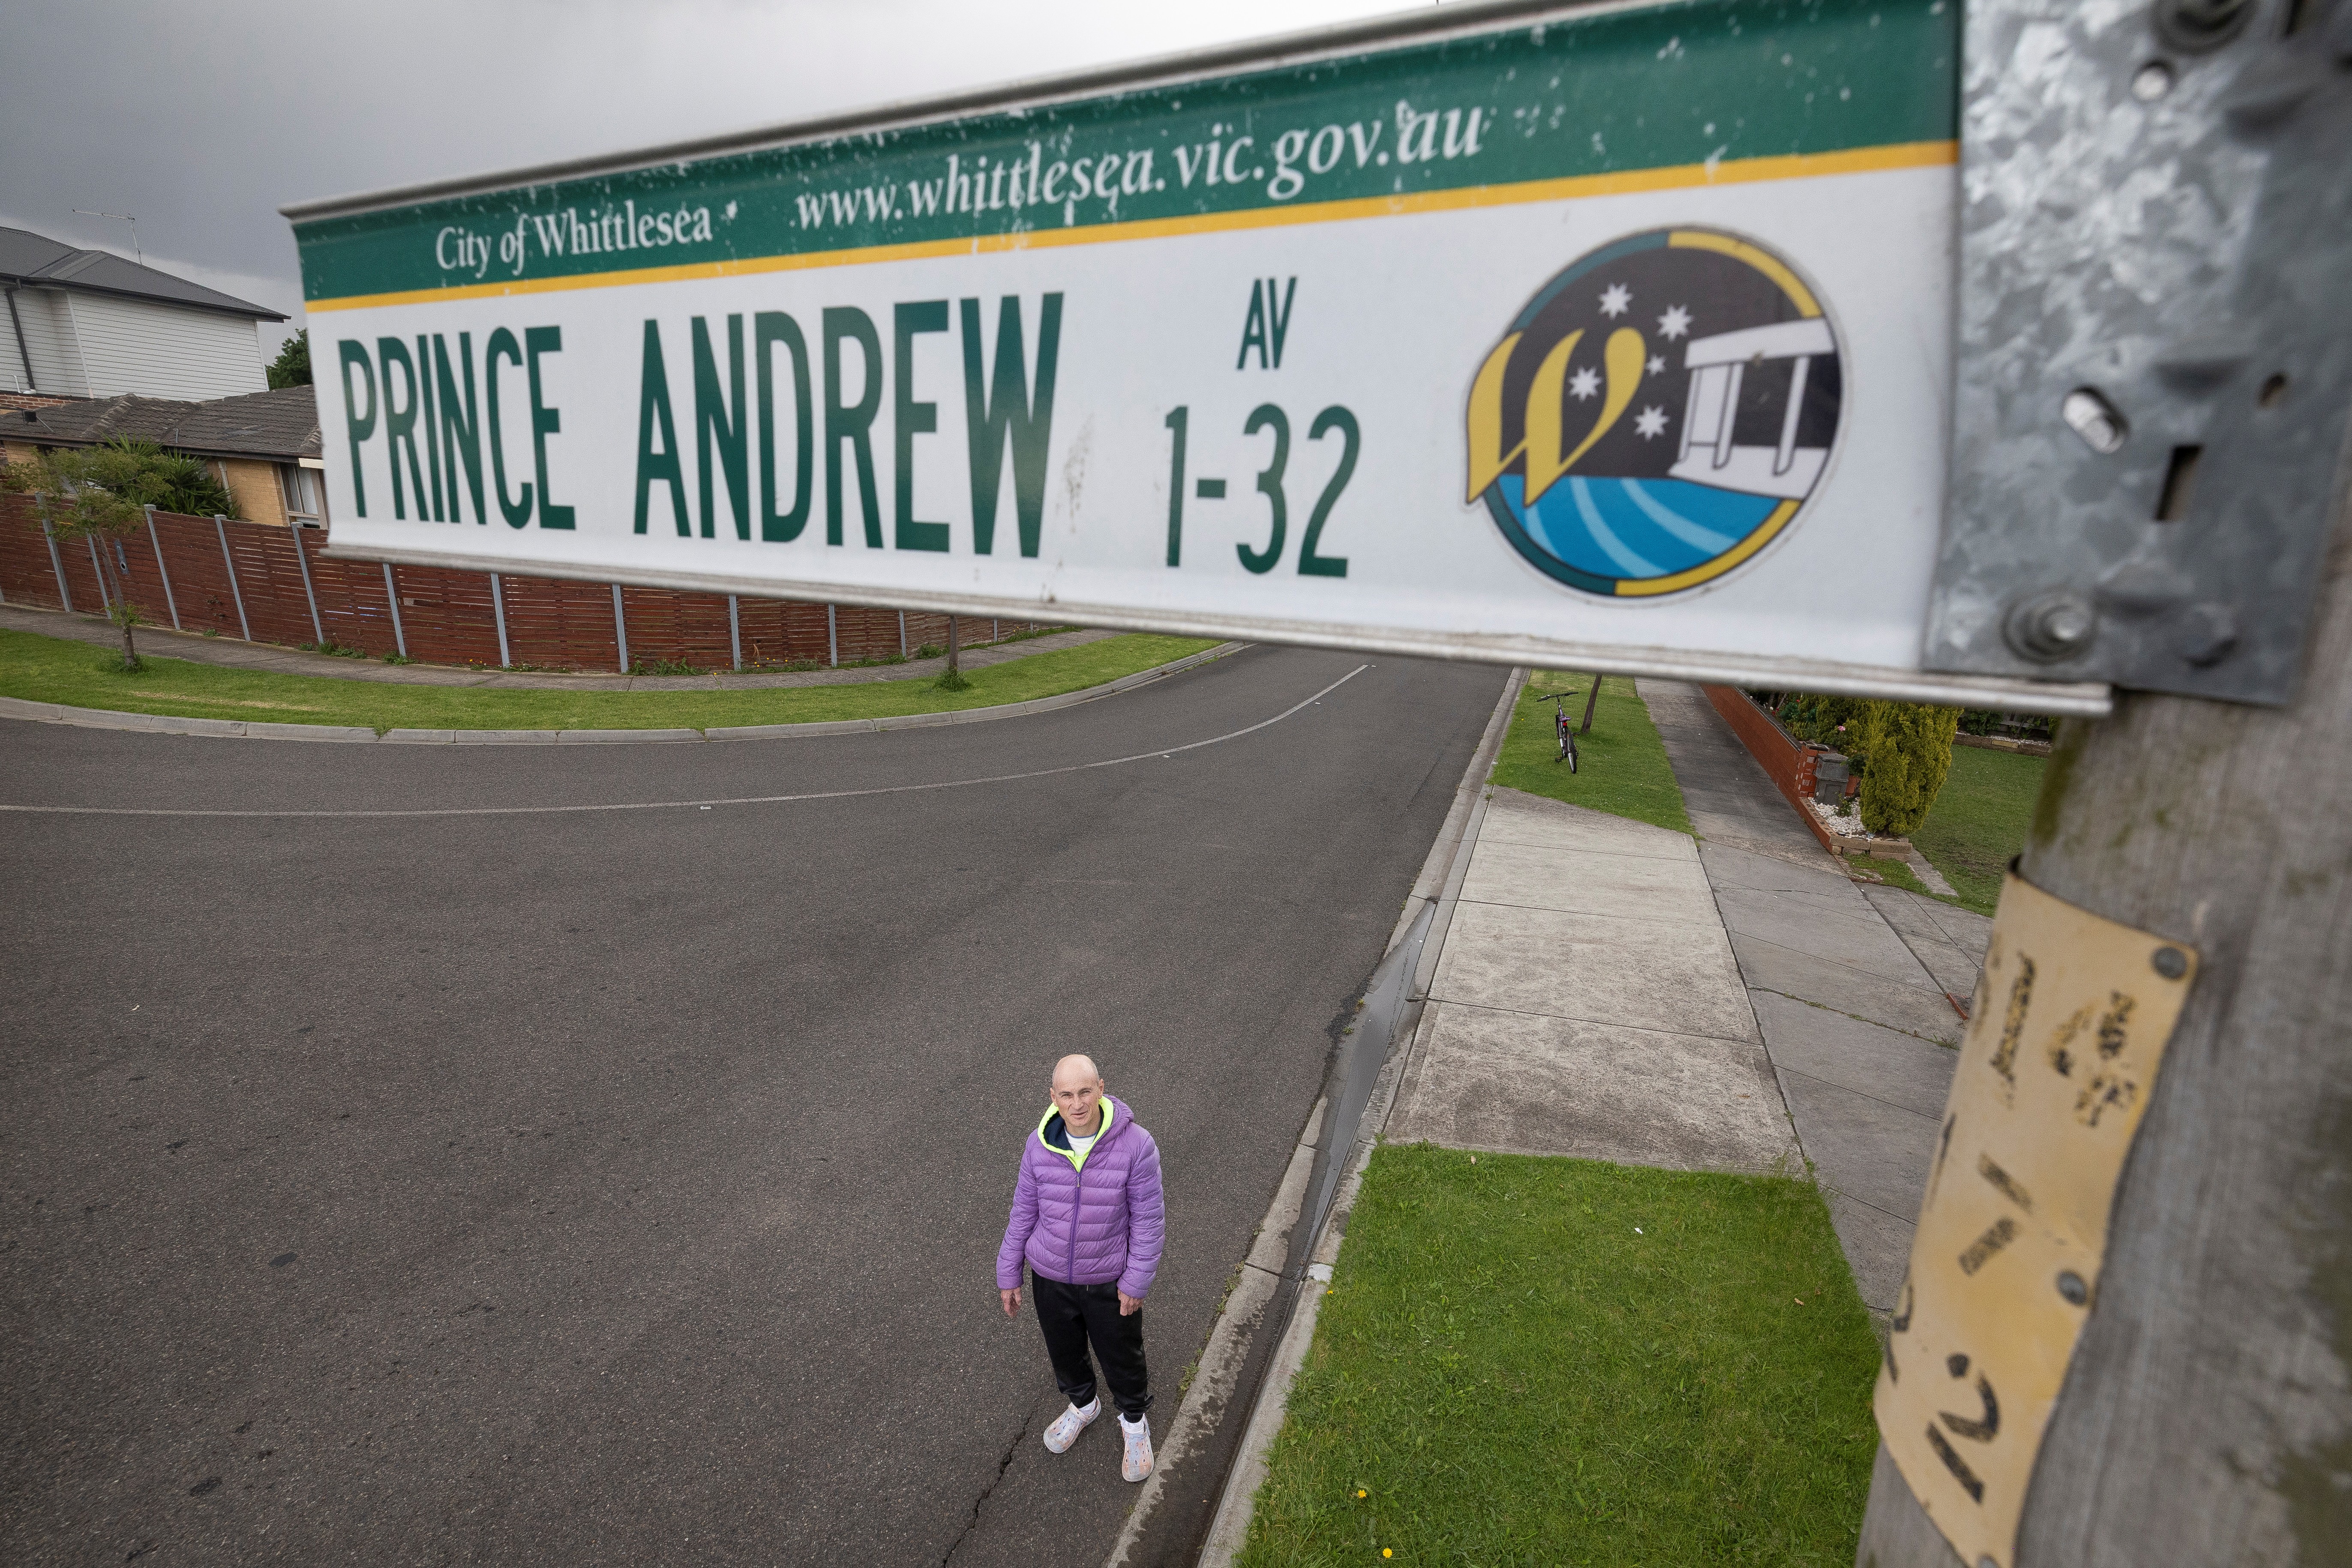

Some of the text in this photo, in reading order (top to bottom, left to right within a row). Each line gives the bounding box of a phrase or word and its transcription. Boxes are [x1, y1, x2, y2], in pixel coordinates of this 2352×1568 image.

[795, 104, 1485, 231] www.whittlesea.vic.gov.au
[435, 199, 714, 279] City of Whittlesea
[1237, 276, 1298, 371] AV
[337, 291, 1065, 559] PRINCE ANDREW
[1164, 402, 1362, 579] 1-32
